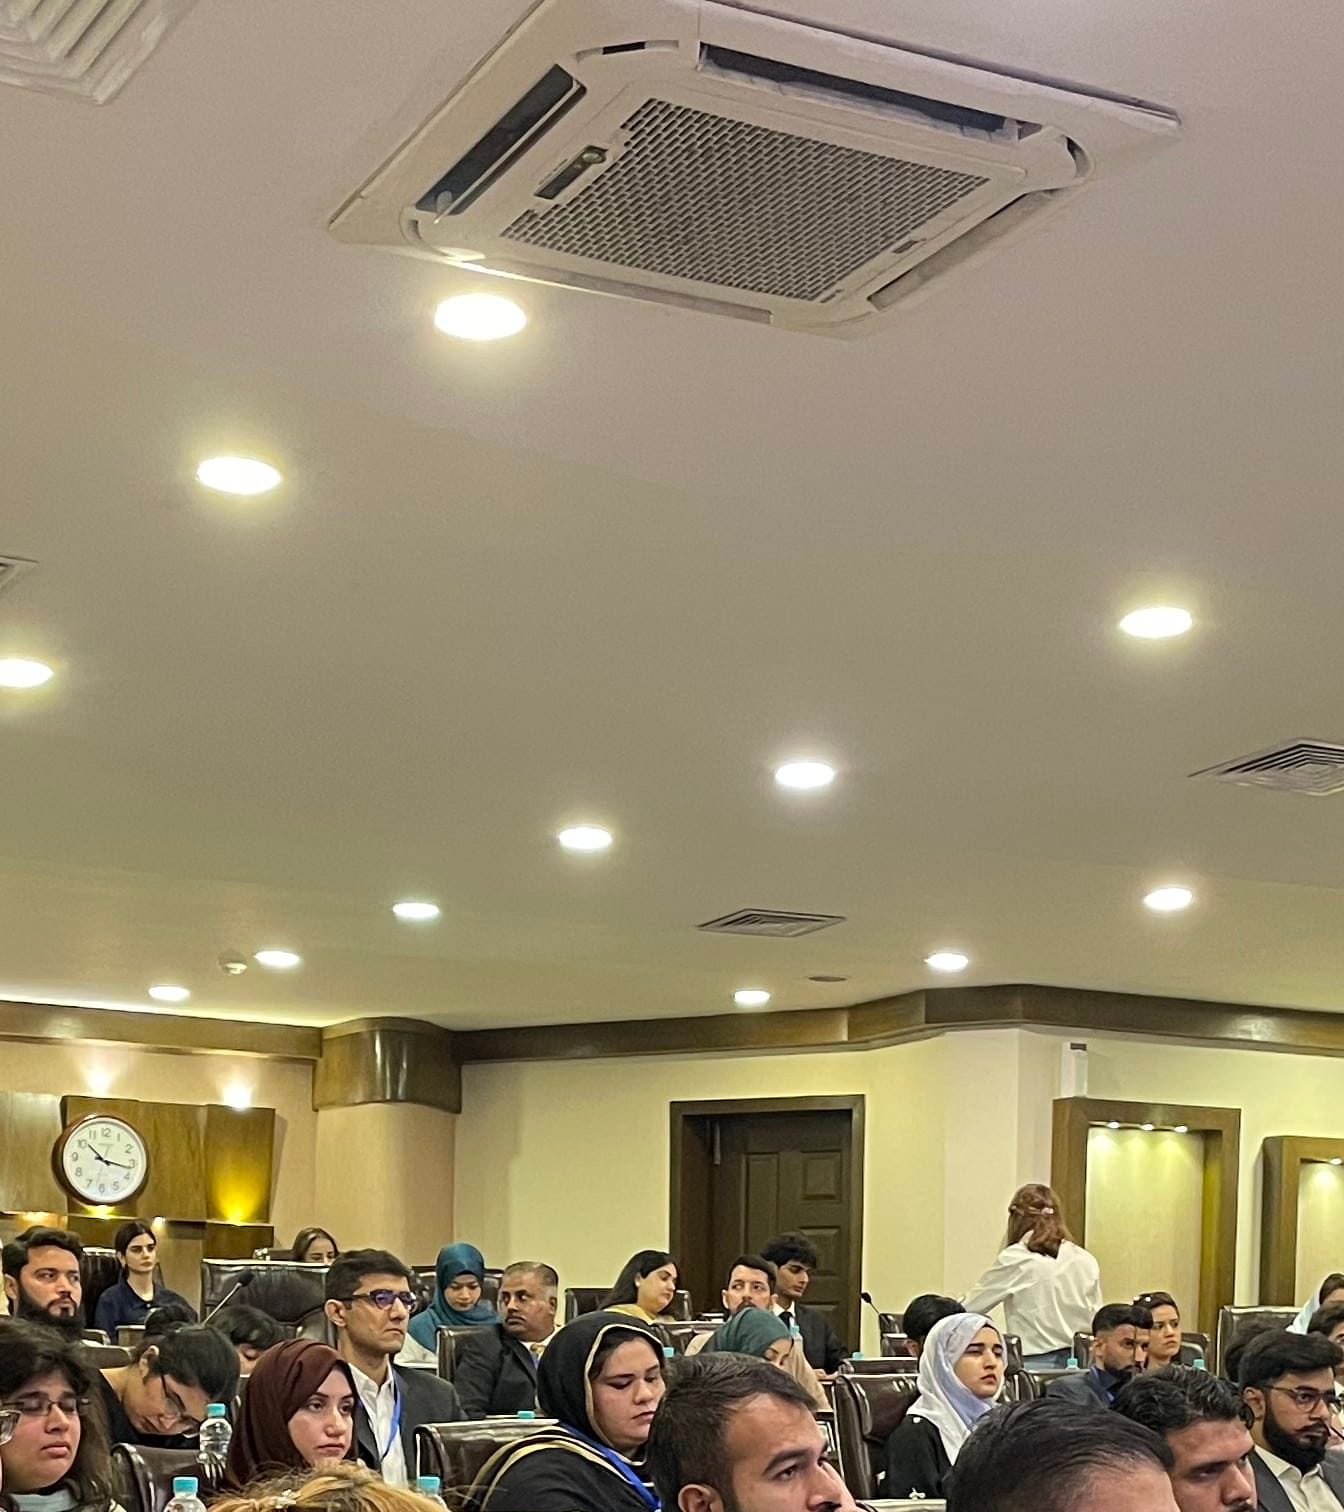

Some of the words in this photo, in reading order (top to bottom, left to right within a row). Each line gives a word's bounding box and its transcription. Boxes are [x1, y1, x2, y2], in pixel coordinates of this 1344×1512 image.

[88, 1129, 97, 1140] 11
[101, 1127, 112, 1138] 12
[116, 1132, 121, 1142] 1
[77, 1138, 88, 1149] 10
[124, 1143, 133, 1153] 2
[71, 1151, 79, 1162] 9
[128, 1158, 136, 1169] 3
[74, 1166, 83, 1177] 8
[123, 1172, 131, 1180] 4
[86, 1178, 94, 1188] 7
[98, 1183, 106, 1194] 6
[112, 1180, 120, 1191] 5
